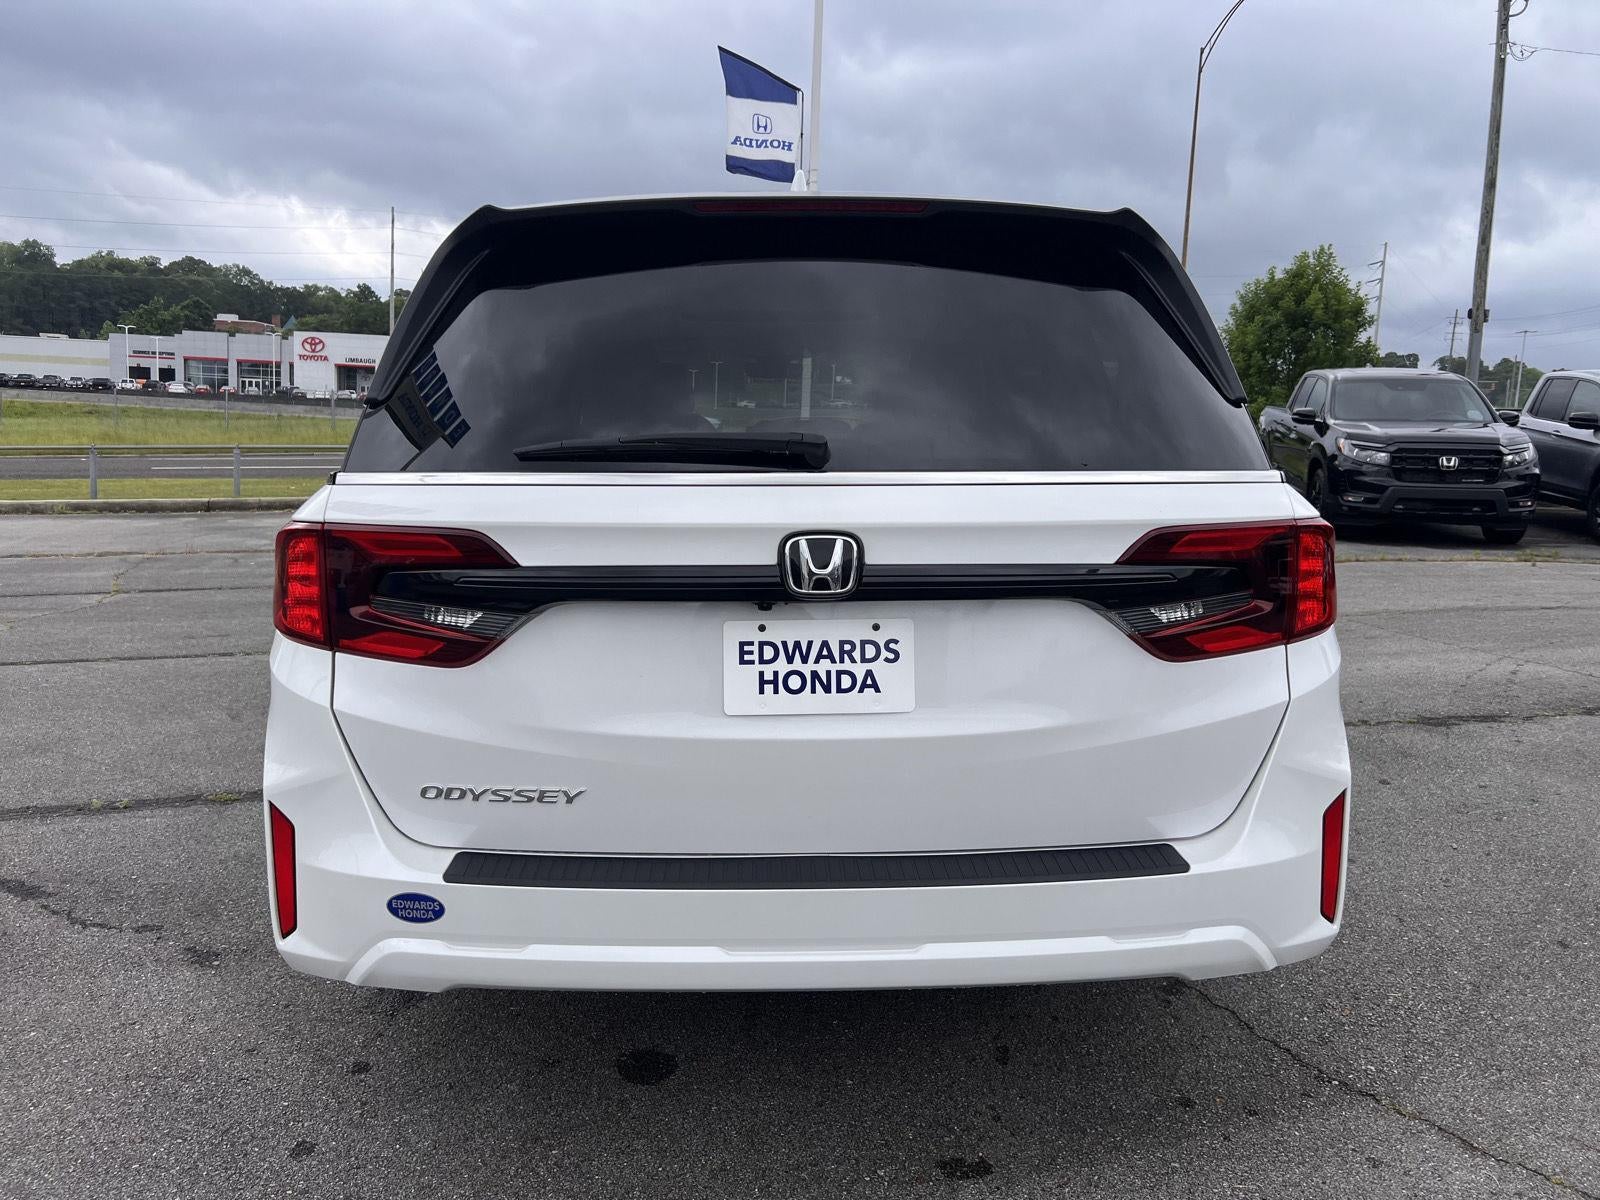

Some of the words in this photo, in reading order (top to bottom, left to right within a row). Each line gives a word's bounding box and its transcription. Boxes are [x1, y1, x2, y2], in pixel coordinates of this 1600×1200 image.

[298, 354, 329, 362] TOYOTA
[738, 638, 900, 665] EDWARDS
[758, 669, 881, 695] HONDA
[419, 784, 587, 804] ODYSSEY
[391, 899, 440, 911] EDWARDS
[398, 908, 435, 920] HONDA
